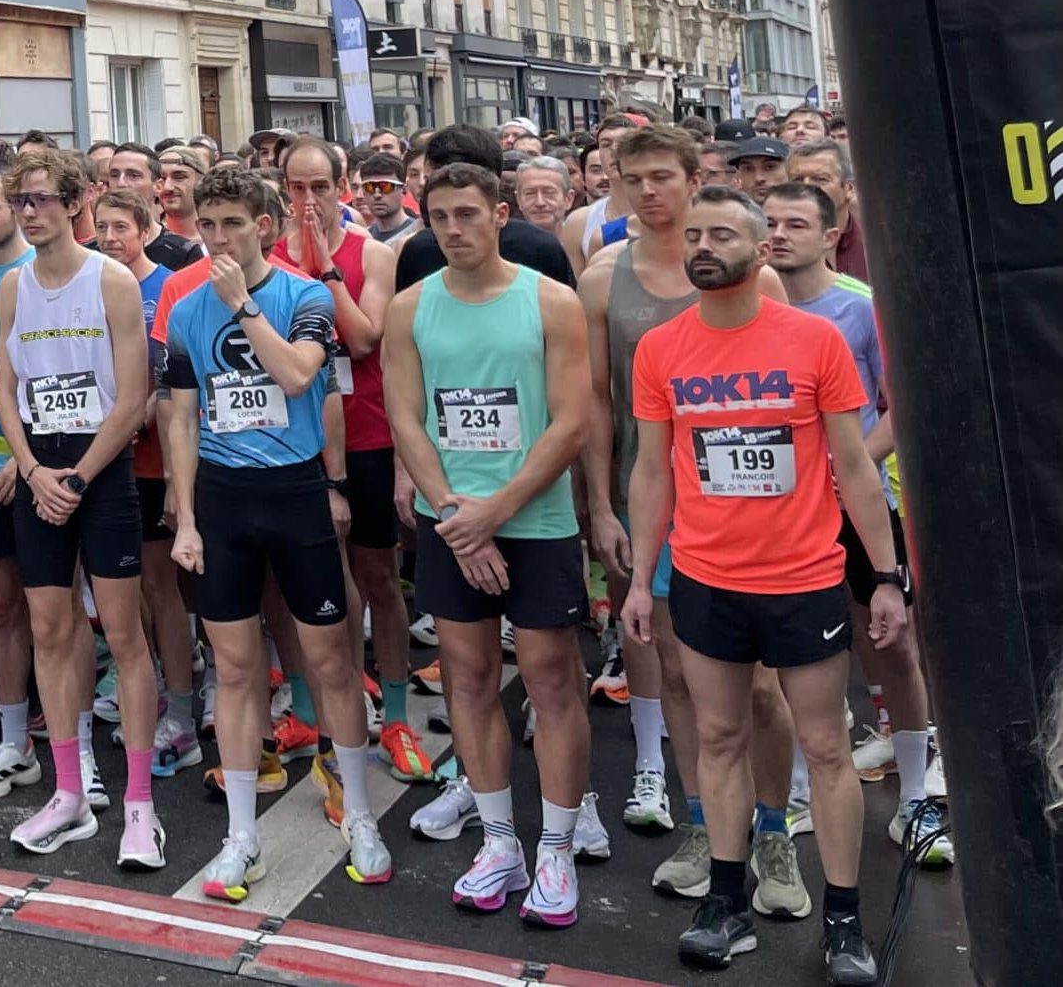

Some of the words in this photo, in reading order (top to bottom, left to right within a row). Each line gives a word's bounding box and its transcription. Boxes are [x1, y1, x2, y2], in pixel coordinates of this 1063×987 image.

[375, 31, 398, 55] 土
[670, 370, 795, 406] 10K14
[44, 391, 88, 412] 2497
[229, 389, 268, 410] 280
[459, 408, 502, 429] 234
[742, 432, 758, 445] 18
[727, 448, 775, 471] 199
[731, 472, 775, 481] FRANCOIS
